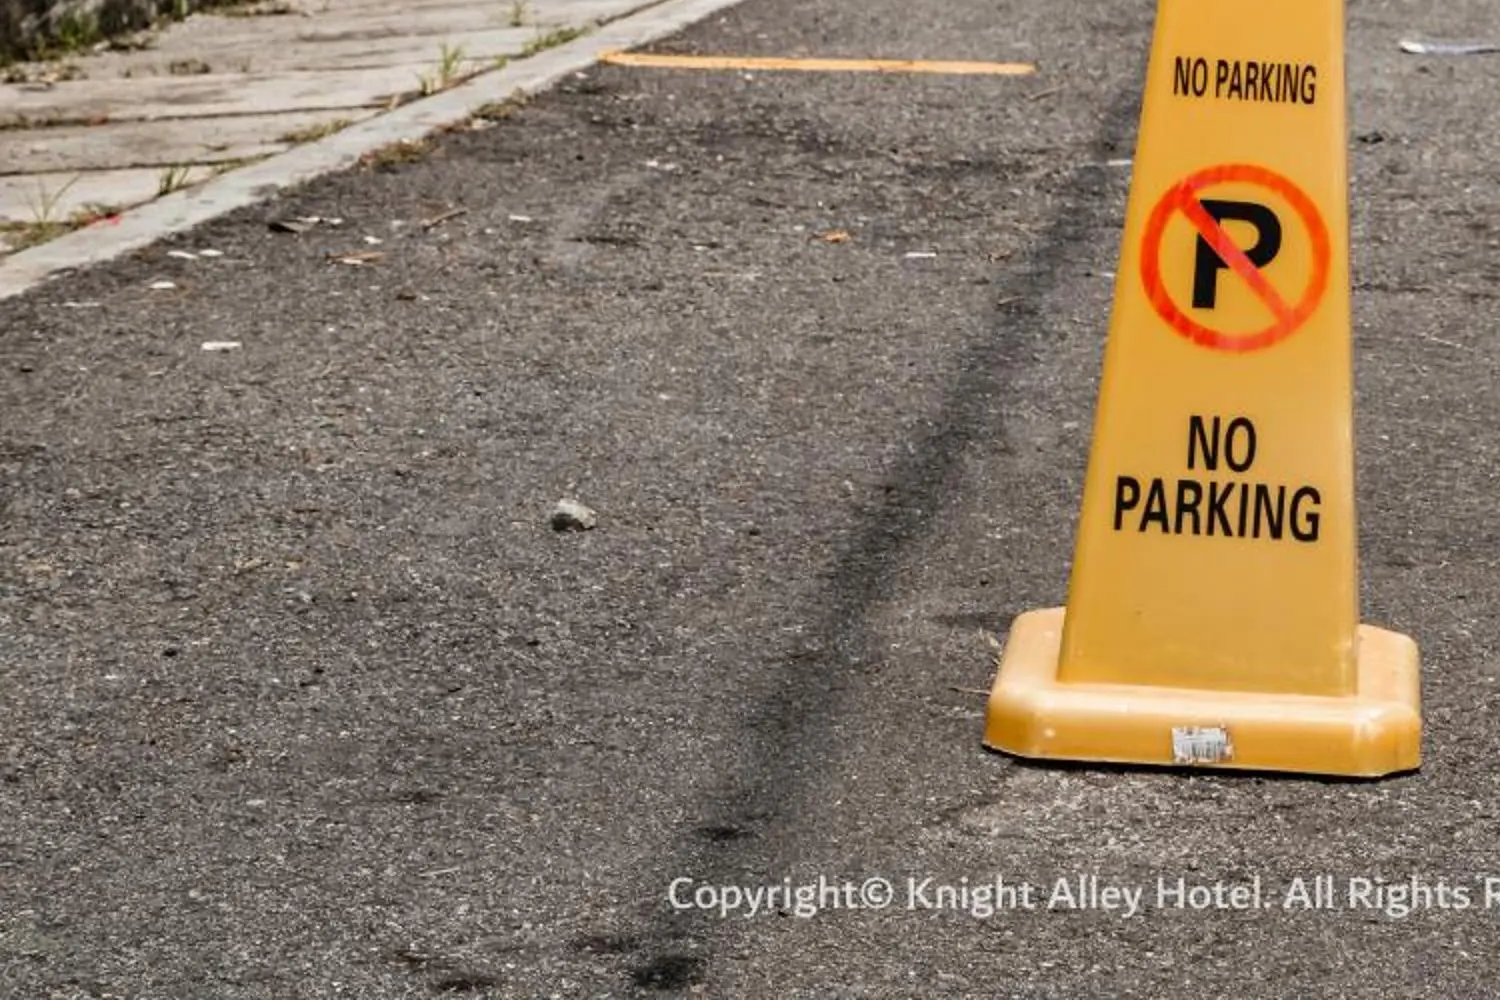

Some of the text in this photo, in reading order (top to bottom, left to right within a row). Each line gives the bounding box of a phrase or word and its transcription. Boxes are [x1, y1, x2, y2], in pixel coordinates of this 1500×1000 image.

[1173, 55, 1317, 105] NO PARKING
[1191, 199, 1283, 310] P
[1186, 414, 1257, 473] NO
[1113, 475, 1322, 543] PARKING
